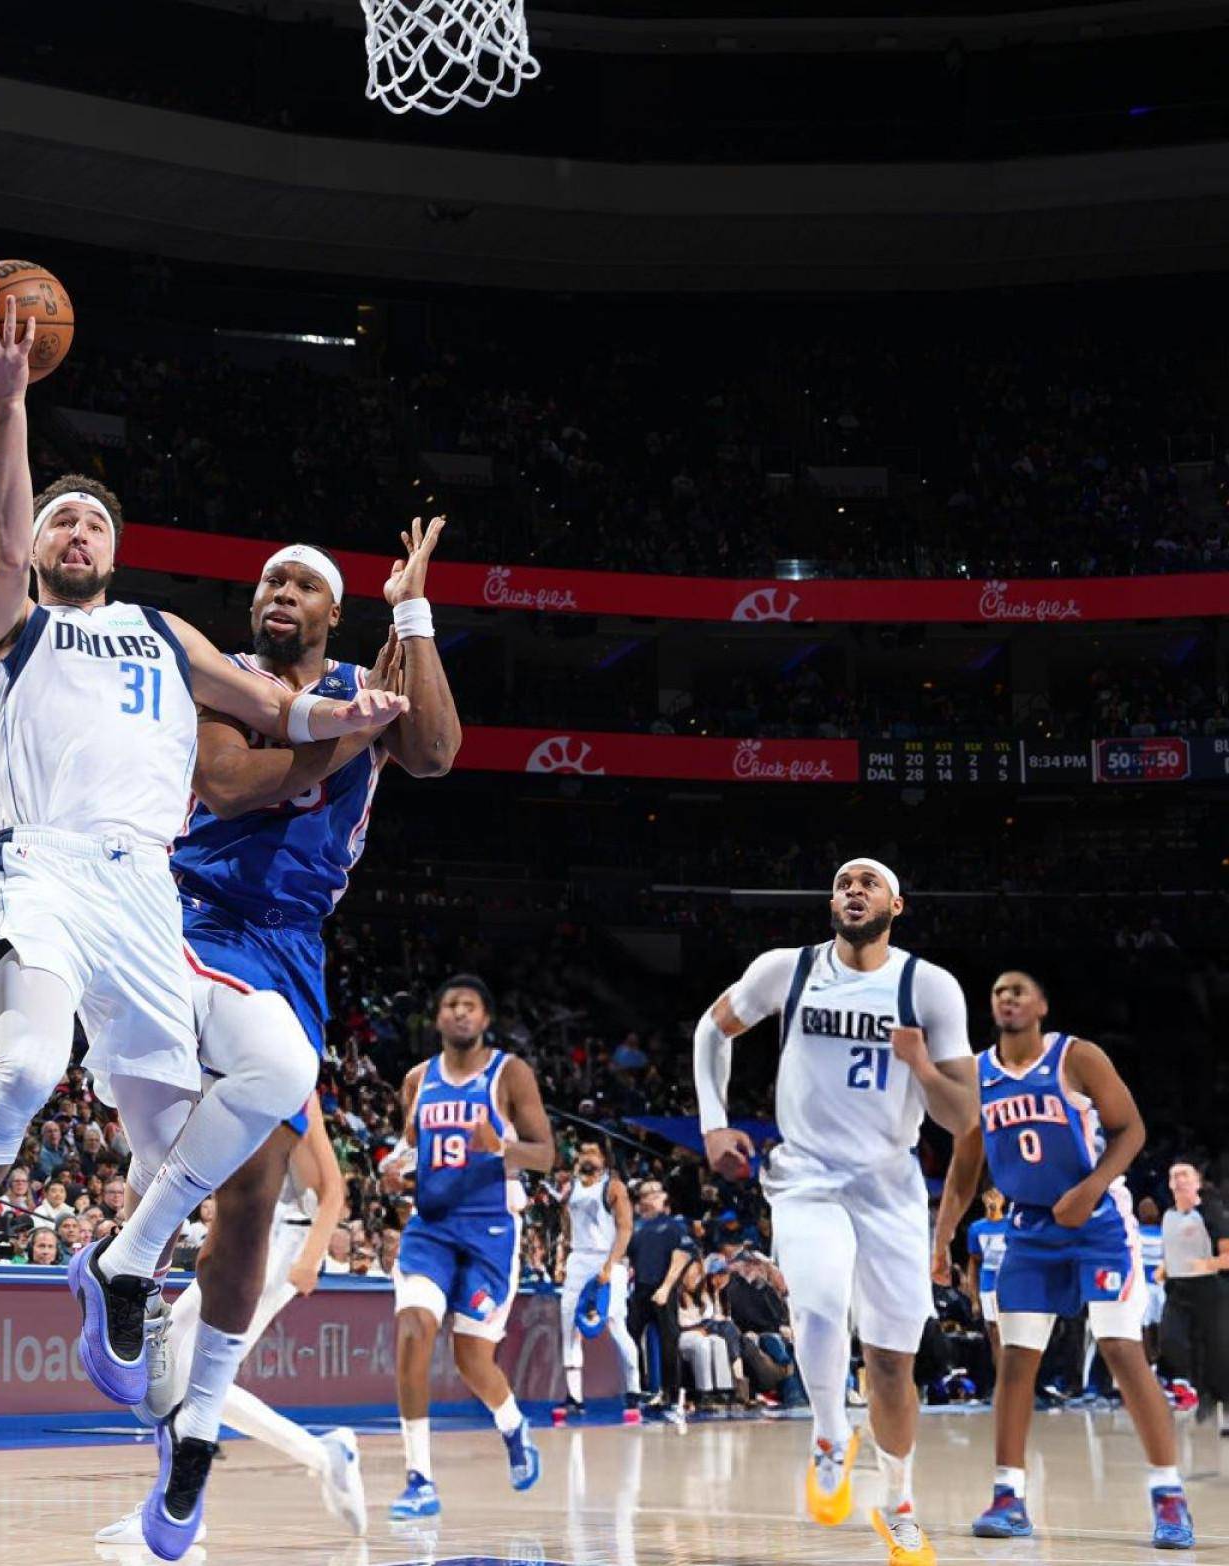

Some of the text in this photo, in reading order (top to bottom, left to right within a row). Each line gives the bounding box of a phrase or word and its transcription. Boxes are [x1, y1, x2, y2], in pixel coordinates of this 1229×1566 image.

[484, 575, 578, 610] Chick-fil-A
[979, 589, 1083, 622] Chick-fil-A
[54, 621, 161, 659] DALLAS
[119, 661, 161, 721] 31
[733, 748, 835, 781] Chick-fil-A
[867, 768, 1008, 782] DAL 28 14 3 5
[868, 753, 1008, 766] PHI 20 21 2 4
[1028, 755, 1087, 768] 8:34 PM
[1108, 753, 1130, 768] 50
[1156, 751, 1180, 767] 50
[802, 1007, 894, 1042] DALLAS
[847, 1047, 889, 1091] 21
[982, 1093, 1069, 1132] PHILA
[433, 1134, 466, 1168] 19
[1018, 1128, 1042, 1163] 0
